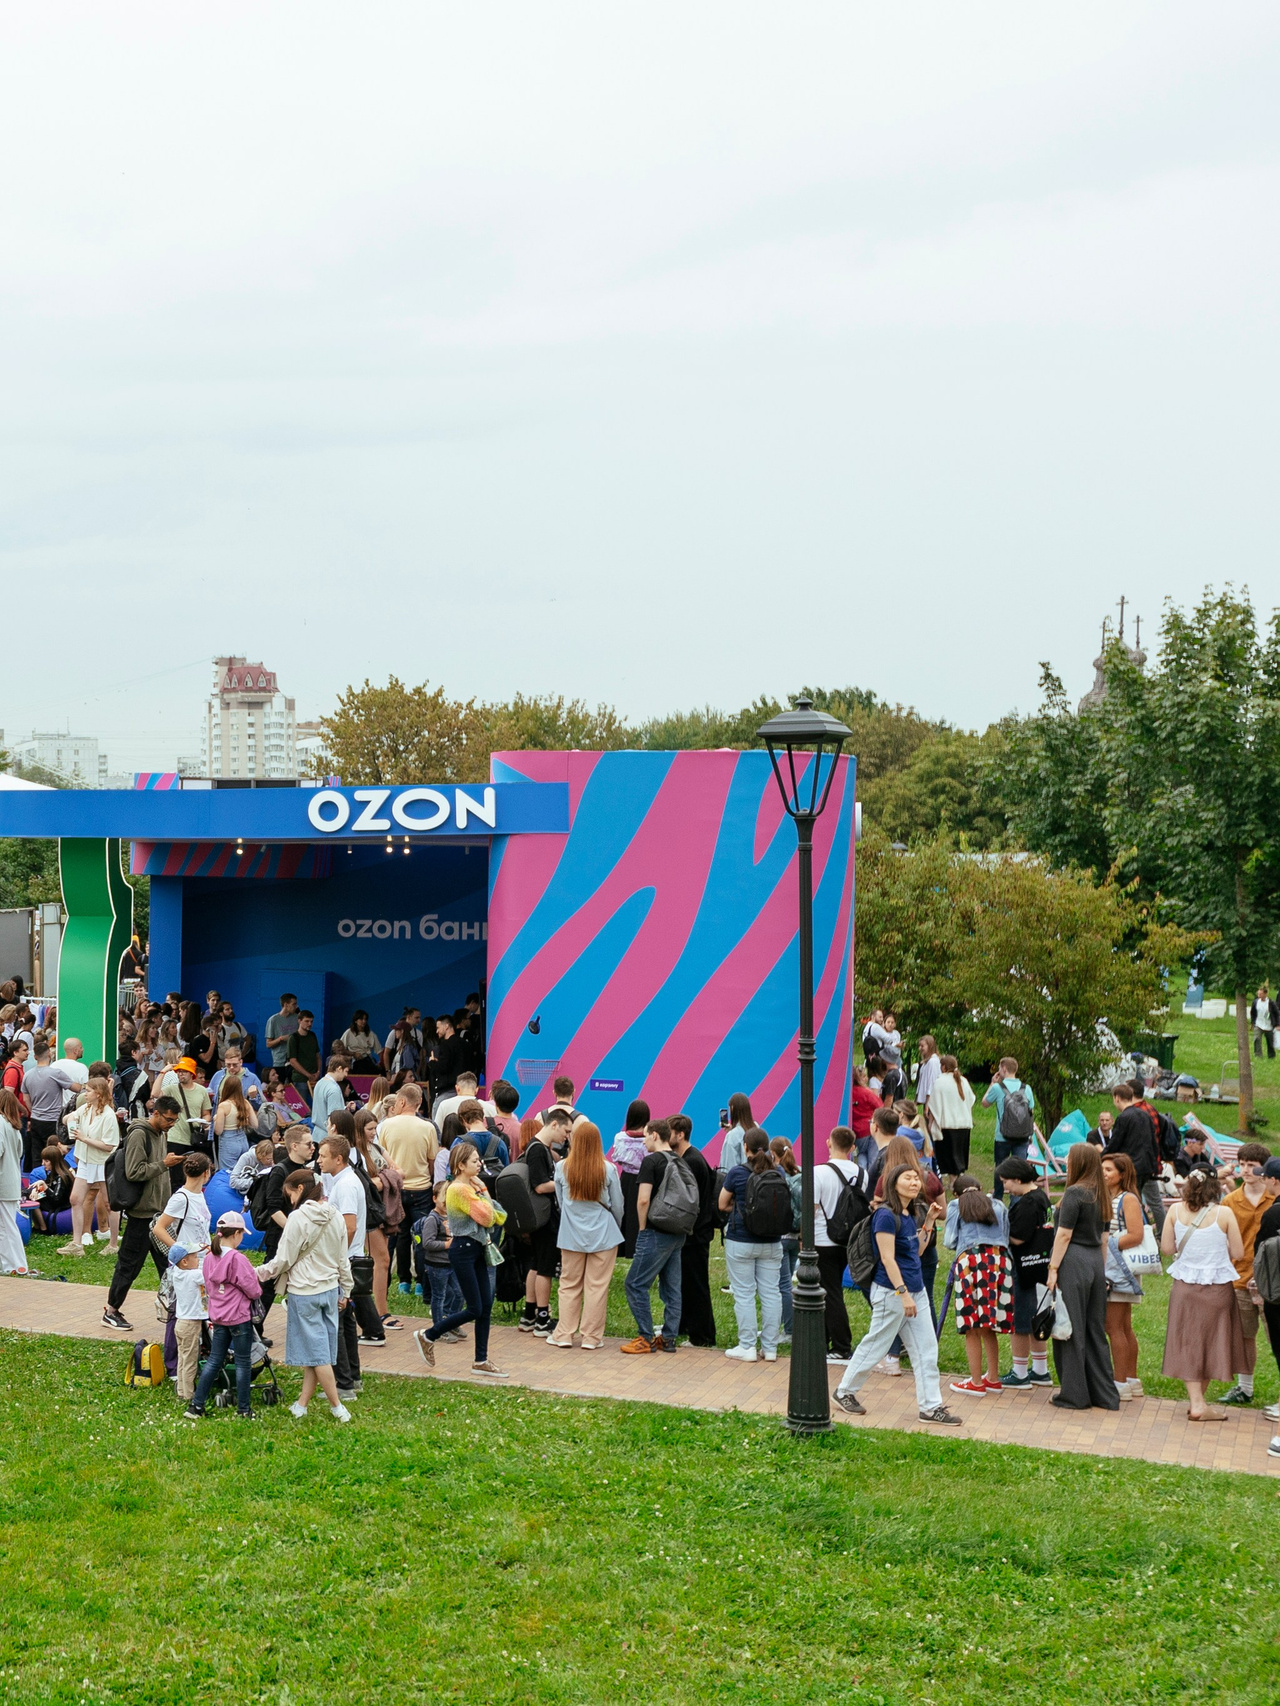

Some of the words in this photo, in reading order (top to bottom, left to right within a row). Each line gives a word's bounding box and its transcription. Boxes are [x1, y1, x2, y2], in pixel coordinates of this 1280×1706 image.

[307, 786, 496, 833] OZON
[337, 919, 411, 940] ozon
[1129, 1254, 1161, 1264] VIBES
